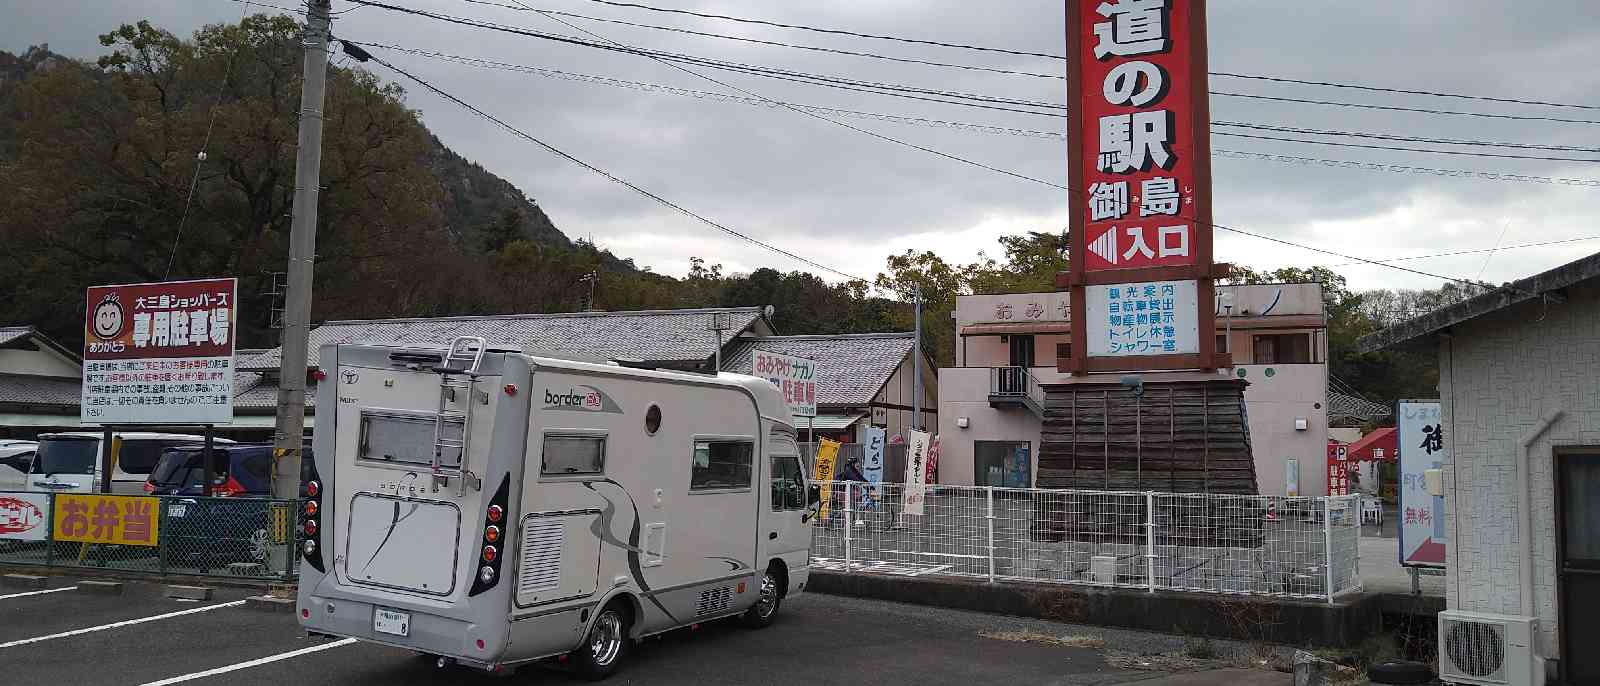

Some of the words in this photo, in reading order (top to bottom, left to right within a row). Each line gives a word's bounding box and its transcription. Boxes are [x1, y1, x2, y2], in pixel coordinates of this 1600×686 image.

[1094, 0, 1174, 173] 道の駅
[1088, 177, 1179, 221] 御島
[1123, 225, 1189, 261] 入口
[1109, 284, 1174, 299] 観光案内
[1109, 298, 1174, 313] 自転車貸出
[133, 308, 230, 348] 専用駐車場
[1109, 326, 1175, 339] トイレ休憩
[89, 341, 125, 353] ありがとう
[1111, 339, 1176, 353] シャワー室
[545, 388, 585, 407] border
[60, 499, 151, 542] お弁当
[1406, 507, 1433, 527] 無料
